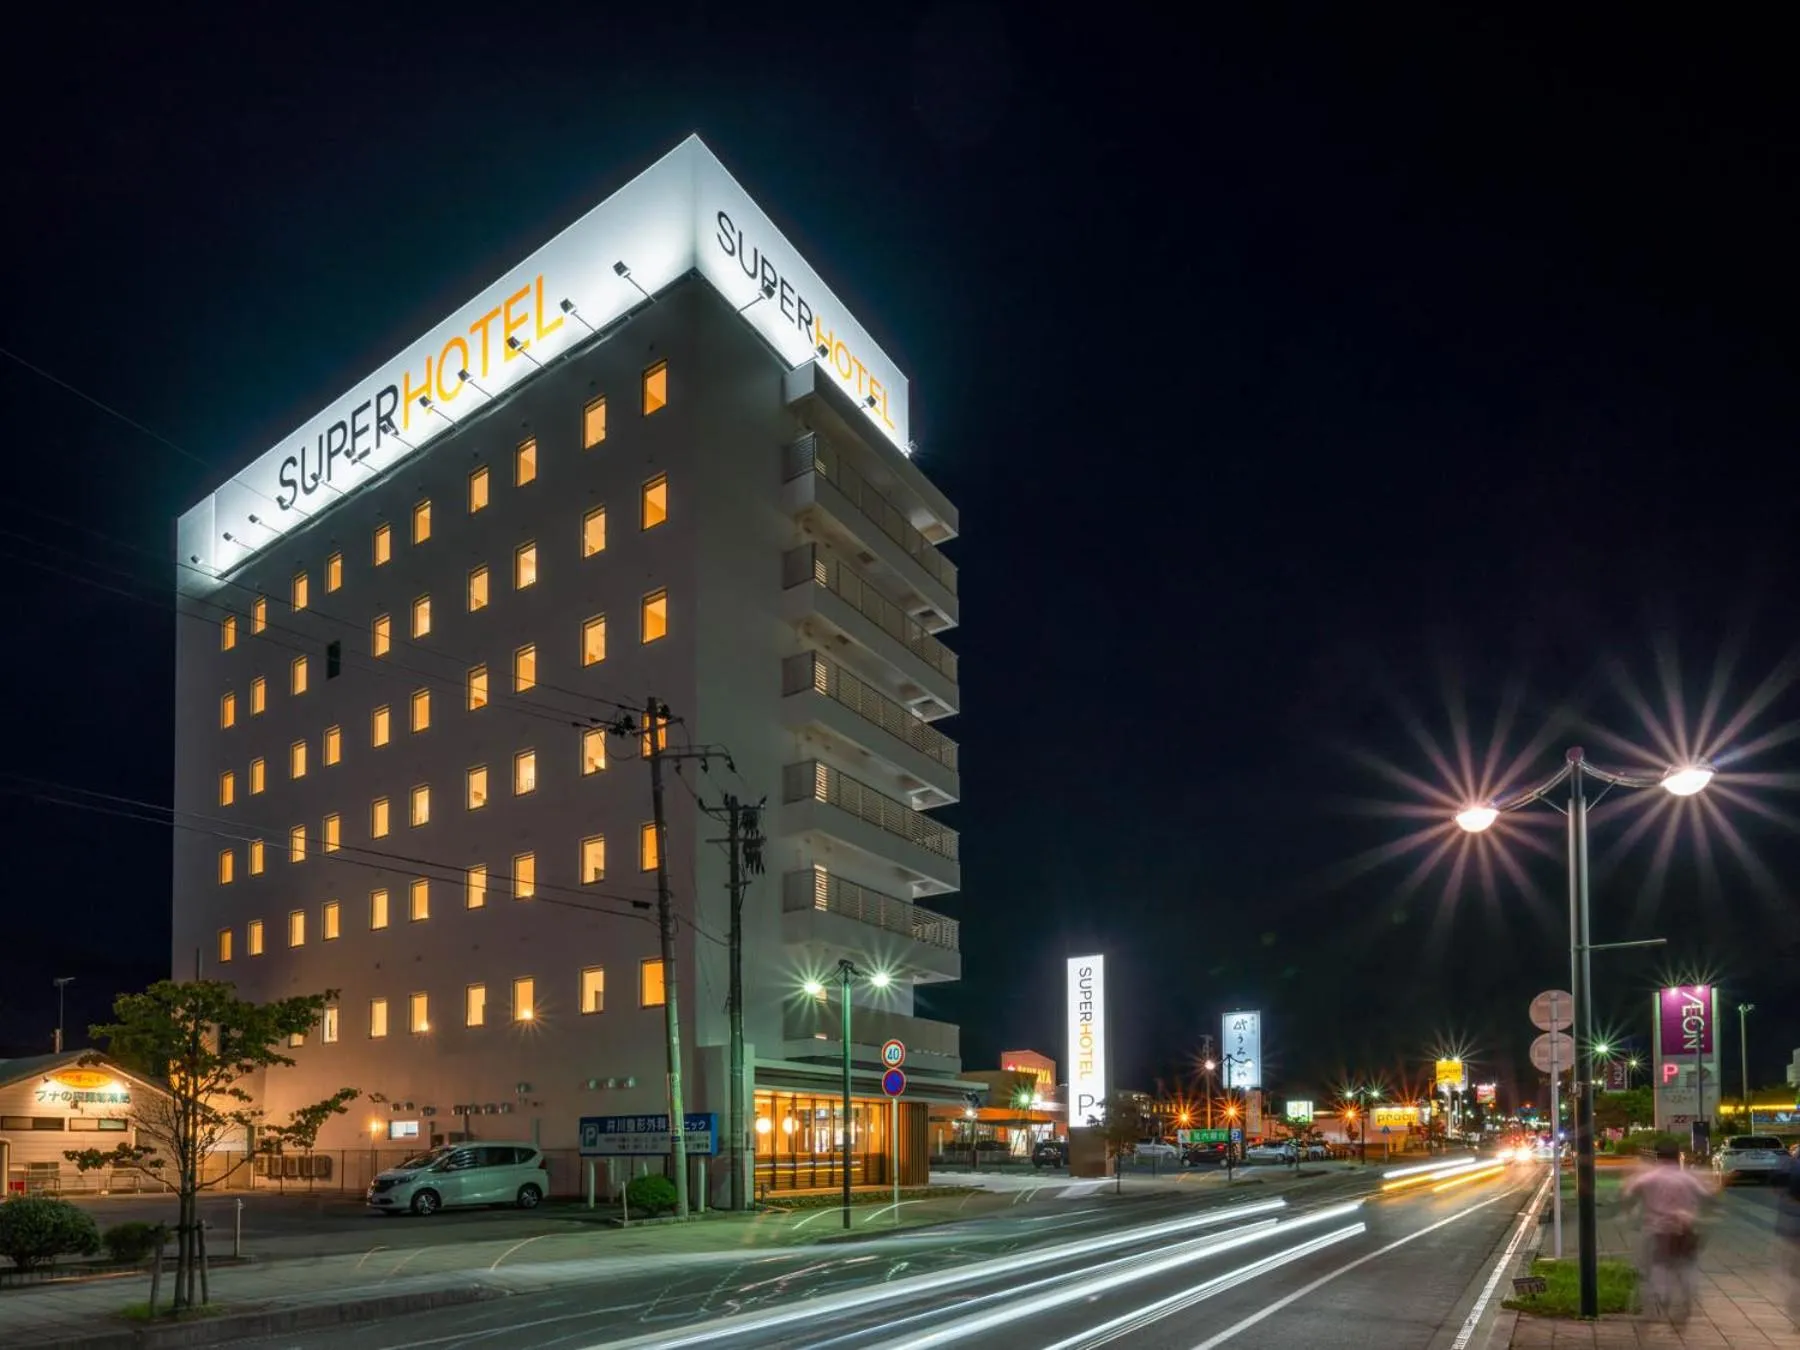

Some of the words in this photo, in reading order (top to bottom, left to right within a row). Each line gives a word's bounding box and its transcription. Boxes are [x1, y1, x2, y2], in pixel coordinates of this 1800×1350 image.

[887, 1048, 900, 1061] 40
[1663, 1064, 1679, 1083] P
[1078, 1093, 1095, 1116] P
[585, 1125, 596, 1143] P
